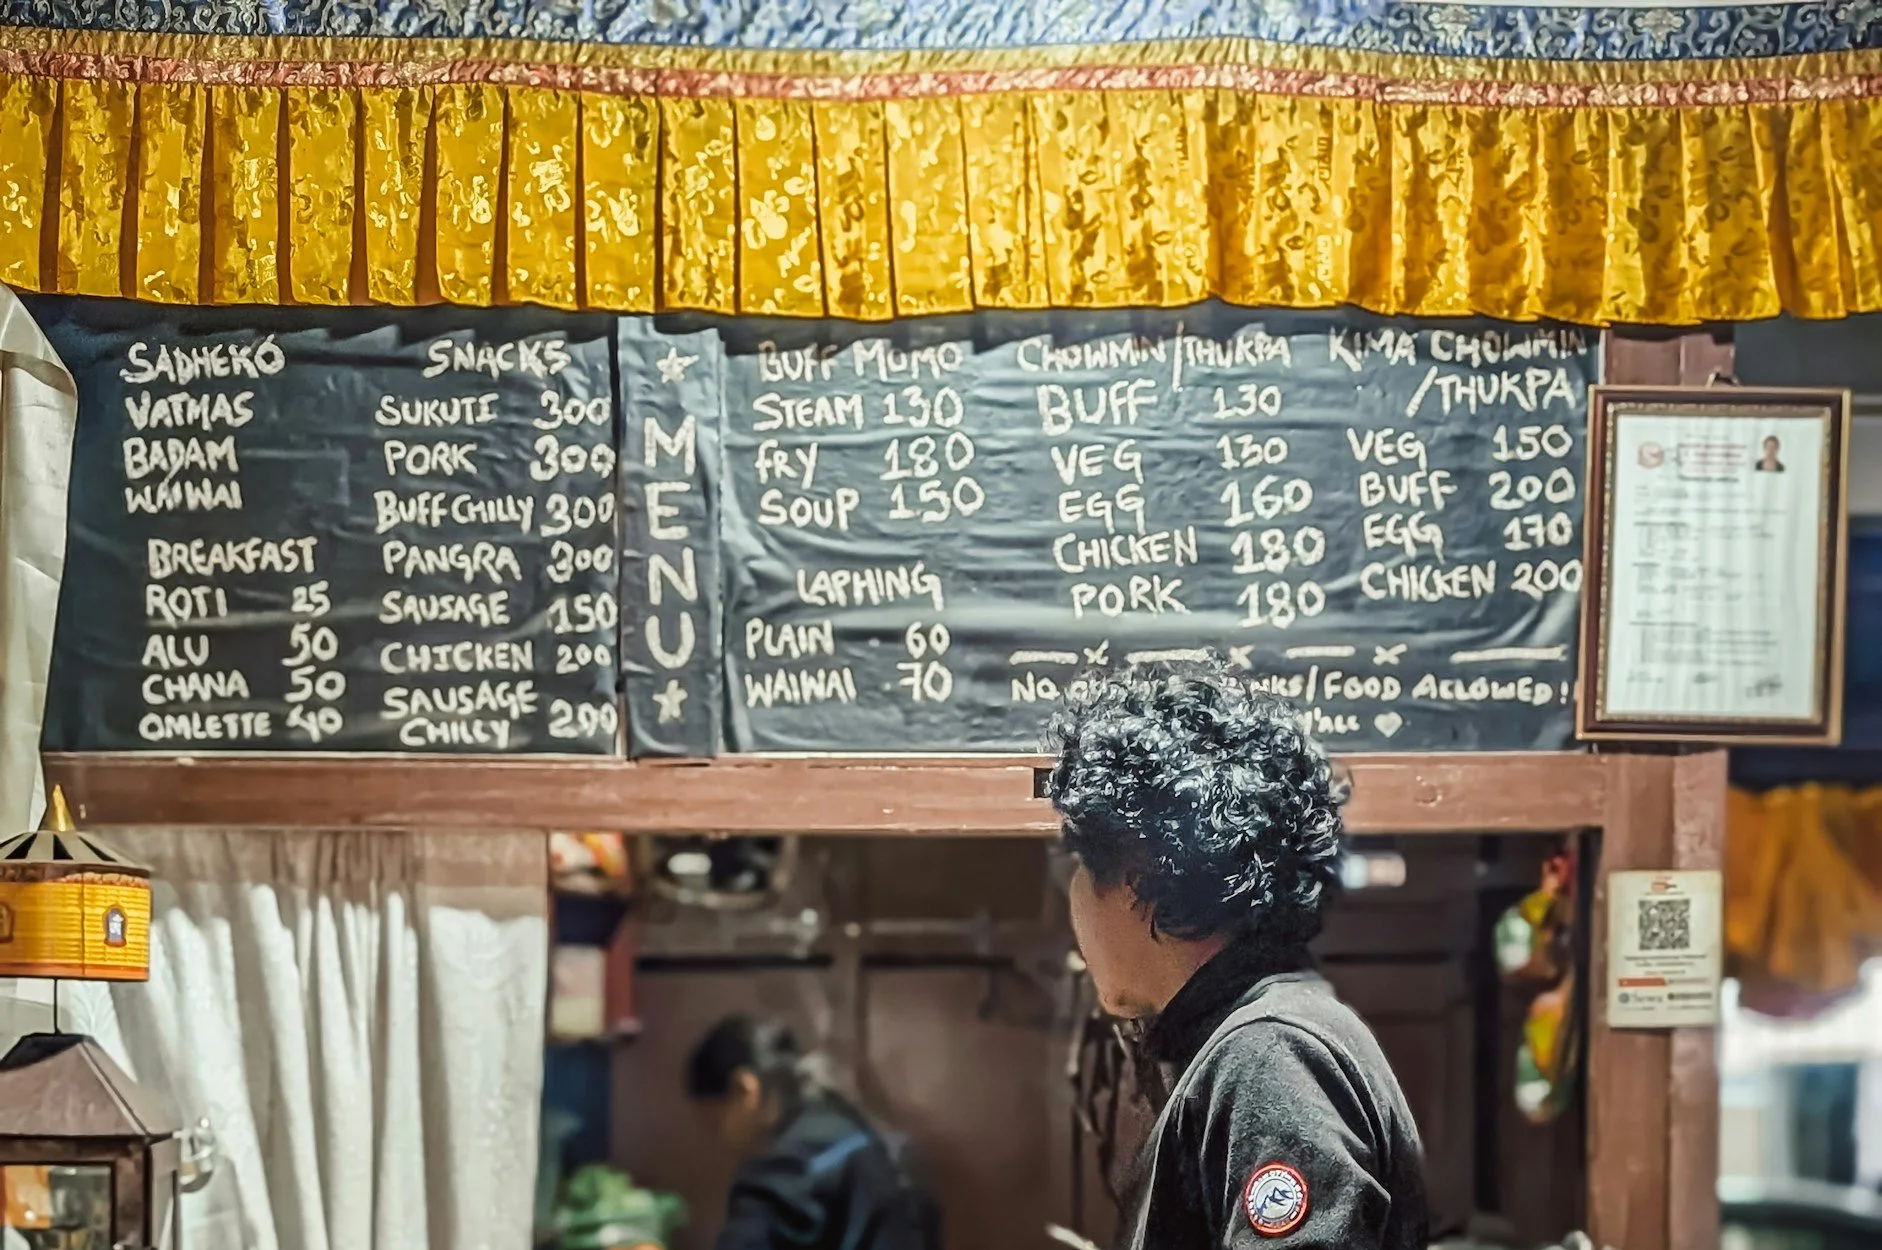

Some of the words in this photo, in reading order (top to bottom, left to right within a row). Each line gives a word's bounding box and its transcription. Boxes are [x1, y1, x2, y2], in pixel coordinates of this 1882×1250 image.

[422, 339, 571, 380] SNACKS
[758, 340, 837, 382] BUFF
[375, 393, 499, 427] SUKUTI
[532, 389, 611, 429] 300
[752, 392, 864, 431] STEAM
[883, 385, 964, 428] 130
[1036, 378, 1157, 435] BUFF
[1213, 383, 1282, 420] 130
[123, 436, 239, 479] BADAM
[383, 439, 478, 476] PORK
[530, 434, 616, 481] 300
[880, 431, 975, 480] 180
[1051, 439, 1144, 486] VEG
[1215, 434, 1288, 471] 130
[1347, 427, 1427, 471] VEG
[1492, 424, 1573, 461] 150
[758, 488, 860, 531] SOUP
[889, 476, 985, 522] 150
[1058, 483, 1145, 535] EGG
[1220, 475, 1313, 527] 160
[1360, 470, 1457, 511] BUFF
[1489, 467, 1575, 510] 200
[540, 492, 615, 537] 300
[148, 536, 317, 579] BREAKFAST
[644, 414, 698, 669] MENU
[1053, 525, 1198, 574] CHICKEN
[1230, 526, 1325, 574] 180
[1363, 511, 1445, 565] EGG
[1503, 512, 1573, 550] 170
[382, 540, 522, 584] PANGRA
[547, 540, 613, 583] 300
[1360, 560, 1496, 601] CHICKEN
[1511, 559, 1583, 600] 200
[146, 584, 227, 629] ROTI
[291, 580, 330, 616] 25
[797, 560, 943, 611] LAPHING
[1071, 574, 1191, 619] PORK
[1237, 580, 1325, 629] 180
[379, 590, 510, 628] SAUSAGE
[548, 592, 618, 634] 150
[142, 634, 210, 670] ALU
[281, 622, 338, 666] 50
[380, 641, 534, 674] CHICKEN
[556, 643, 611, 674] 200
[746, 617, 834, 659] PLAIN
[906, 621, 950, 659] 60
[142, 670, 250, 704] CHANA
[284, 665, 346, 702] 50
[745, 667, 857, 708] WAIWAI
[897, 660, 952, 702] 70
[139, 711, 272, 741] OMLETTE
[286, 704, 343, 742] 40
[380, 679, 538, 719] SAUSAGE
[548, 698, 617, 738] 200
[399, 717, 510, 749] CHILLY
